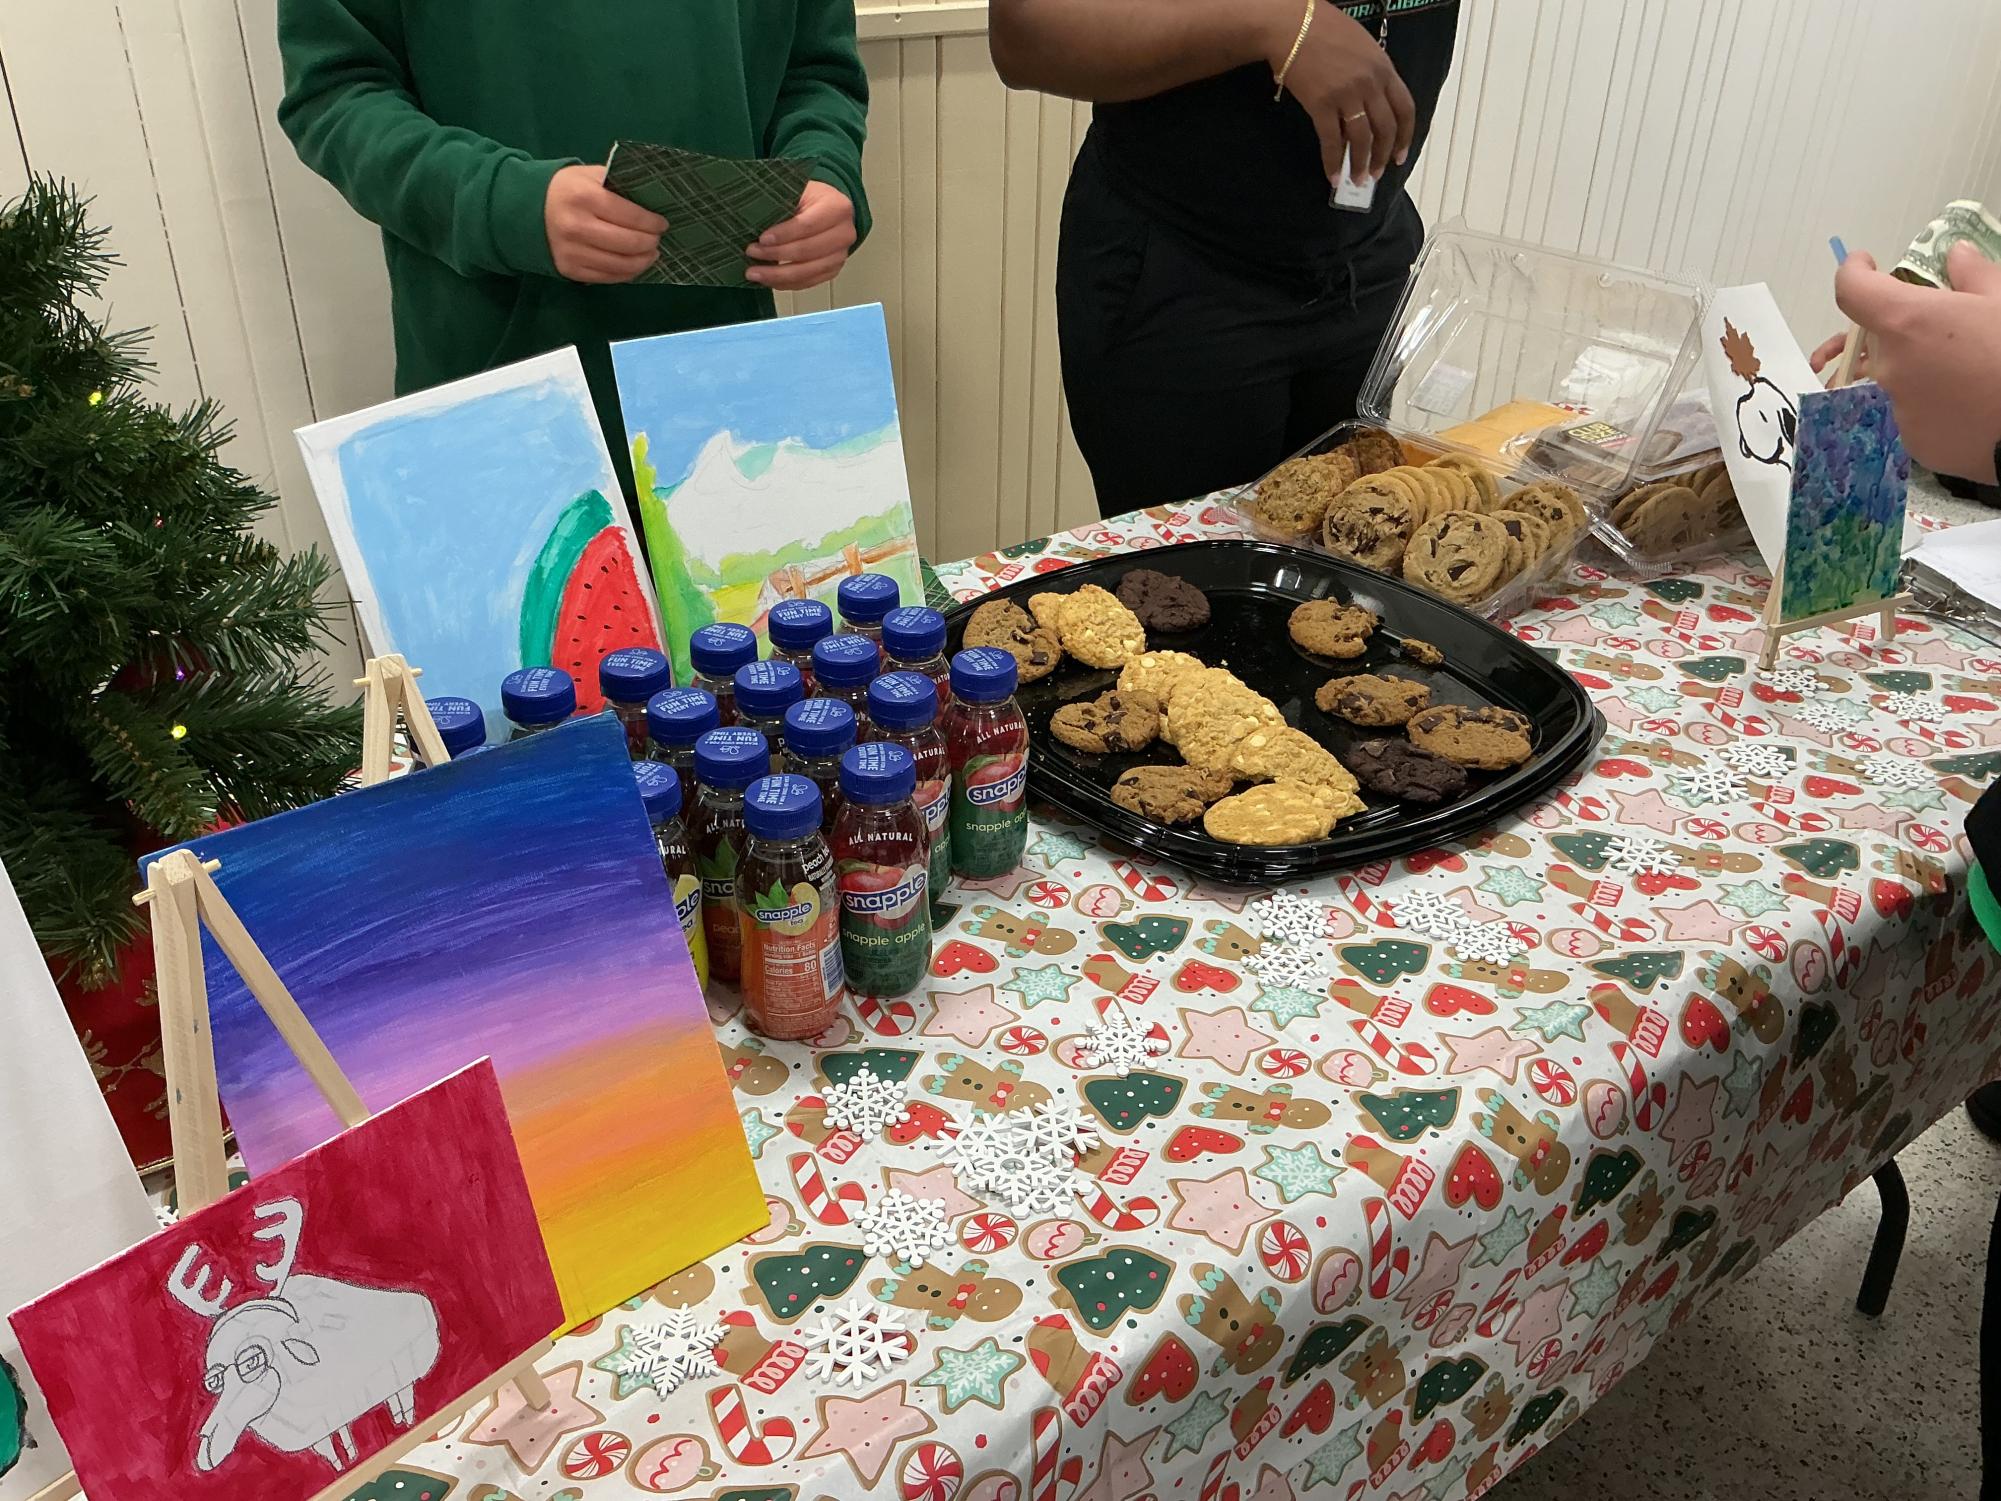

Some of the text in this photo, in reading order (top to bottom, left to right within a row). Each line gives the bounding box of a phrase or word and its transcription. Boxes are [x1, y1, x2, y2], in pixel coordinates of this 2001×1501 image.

[1568, 423, 1610, 436] CLUB
[705, 626, 725, 634] TIME
[823, 642, 846, 650] TIME
[630, 658, 654, 668] TIME
[630, 664, 646, 672] TIME
[748, 664, 756, 674] EVERY
[960, 654, 984, 672] EVERY TIME
[964, 650, 994, 670] FUN TIME
[532, 668, 548, 680] TIME
[756, 662, 769, 685] FUN TIME
[528, 680, 540, 692] FUN
[876, 680, 904, 698] EVERY TIME
[881, 676, 914, 697] FUN TIME
[660, 694, 708, 712] FUN TIME
[667, 700, 708, 715] EVERY TIME
[798, 700, 814, 722] EVERY TIME
[806, 700, 824, 724] FUN TIME
[976, 722, 1024, 744] ALL NATURAL
[858, 746, 867, 770] EVERY TIME
[866, 744, 878, 771] FUN TIME
[757, 778, 770, 802] EVERY TIME
[766, 776, 782, 804] FUN TIME
[972, 770, 1026, 800] snapp
[706, 824, 720, 834] ALL
[966, 820, 1011, 832] snapple
[849, 832, 913, 846] ALL NATURAL
[802, 852, 824, 874] peach
[846, 876, 926, 911] snapple
[758, 904, 810, 920] snapple
[714, 924, 740, 934] peac
[894, 923, 926, 944] apple
[764, 942, 816, 952] Nutrition Facts
[765, 966, 794, 975] Calories
[804, 960, 817, 972] 80
